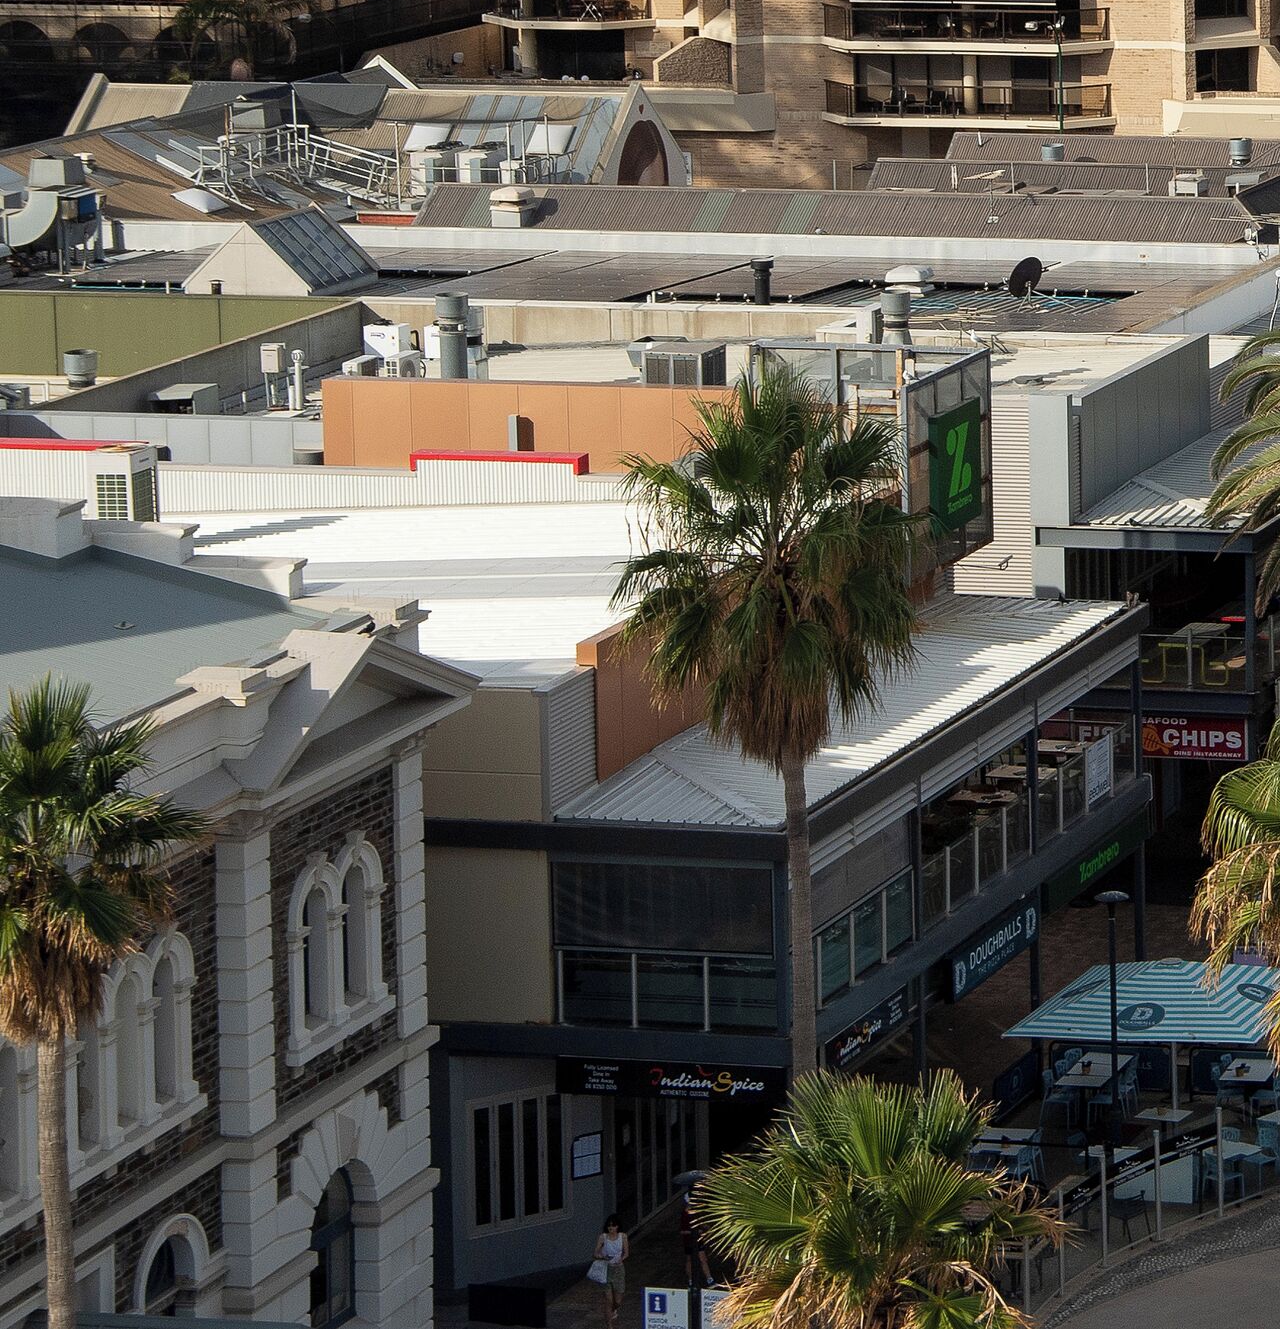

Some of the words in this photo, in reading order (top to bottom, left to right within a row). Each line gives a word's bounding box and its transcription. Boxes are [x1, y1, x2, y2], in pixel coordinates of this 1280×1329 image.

[1163, 729, 1242, 749] CHIPS
[1079, 841, 1120, 884] Zambrero
[969, 916, 1022, 970] DOUGHBALLS
[650, 1068, 713, 1088] Indian
[713, 1071, 765, 1095] Spice
